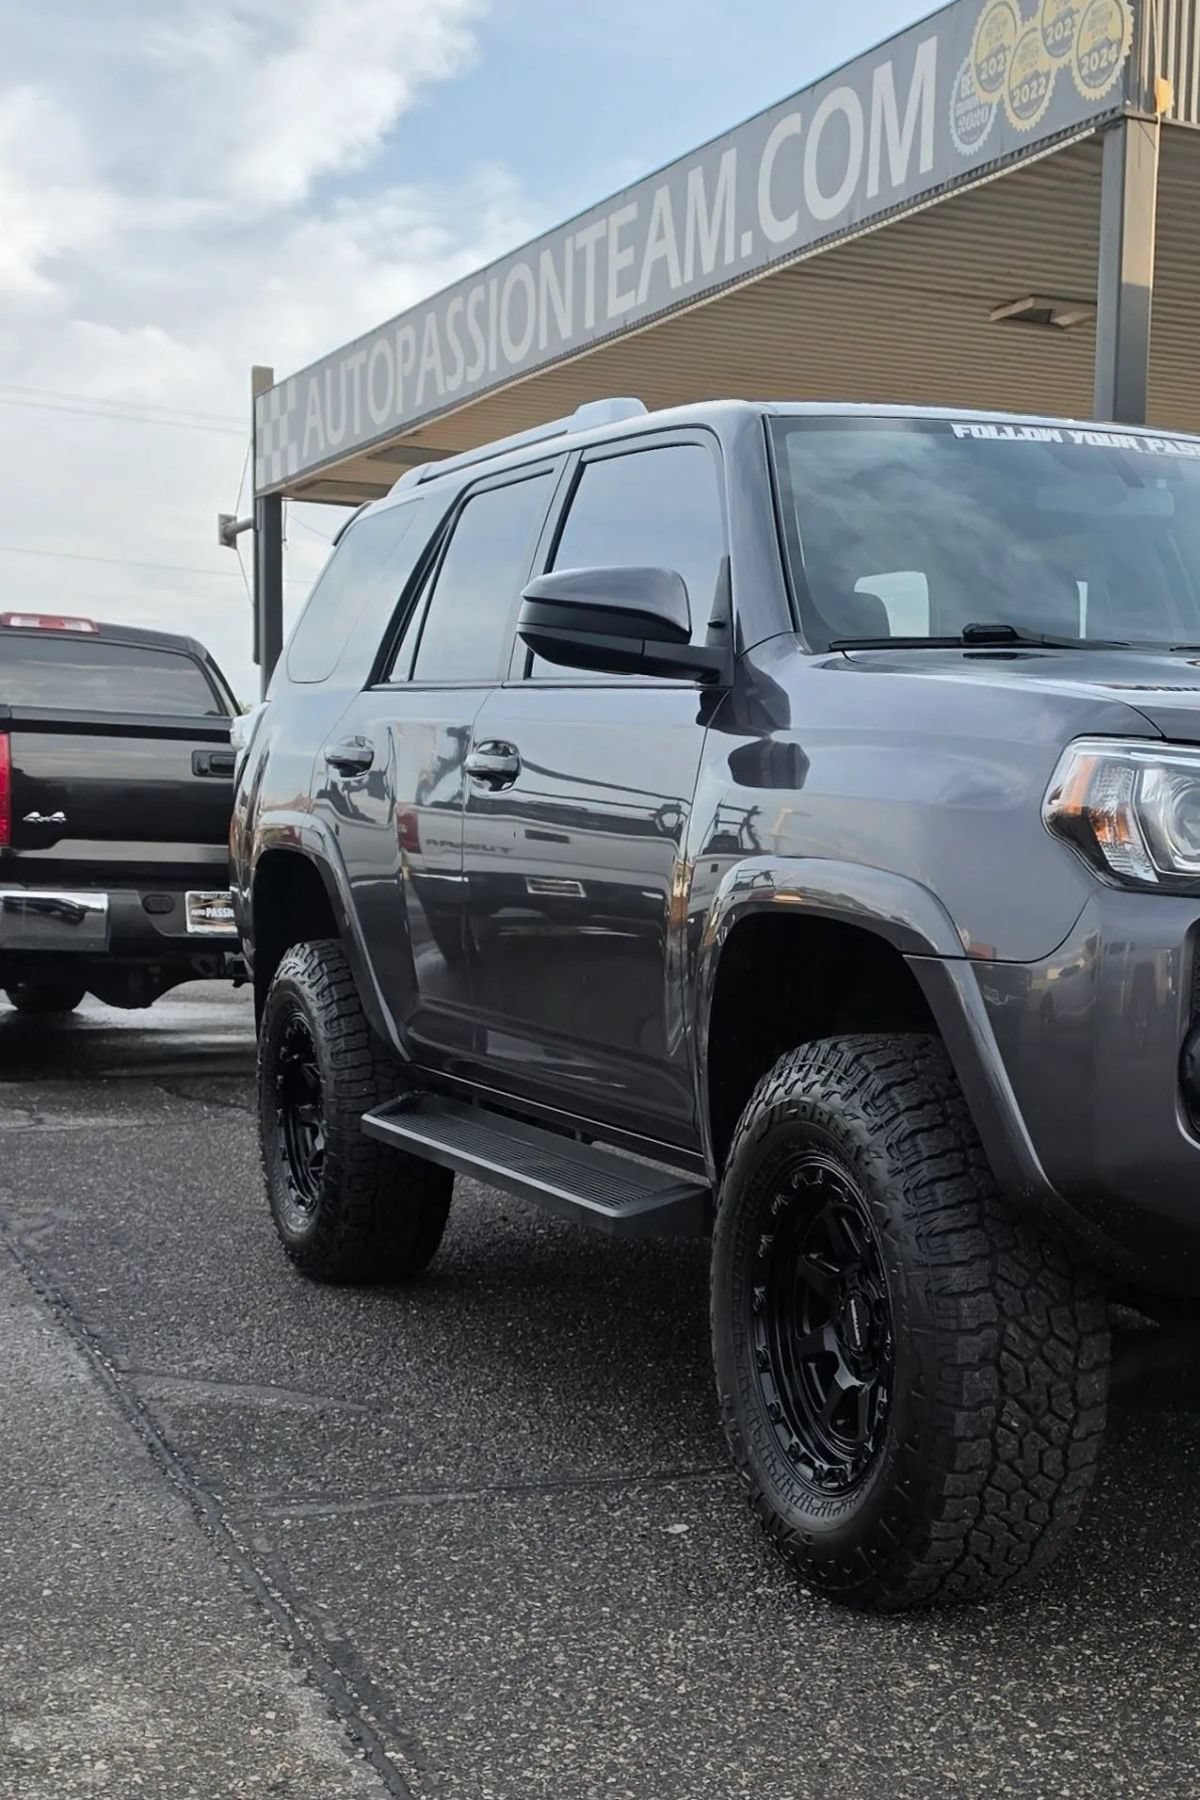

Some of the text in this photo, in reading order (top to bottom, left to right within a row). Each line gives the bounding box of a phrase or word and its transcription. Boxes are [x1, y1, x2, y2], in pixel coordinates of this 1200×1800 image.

[1045, 17, 1073, 47] 202
[980, 51, 1006, 80] 202
[1081, 43, 1118, 77] 2024
[1012, 75, 1047, 108] 2022
[303, 35, 937, 456] AUTOPASSIONTEAM.COM
[951, 423, 1063, 443] FOLLOW
[1070, 430, 1142, 450] YOUR
